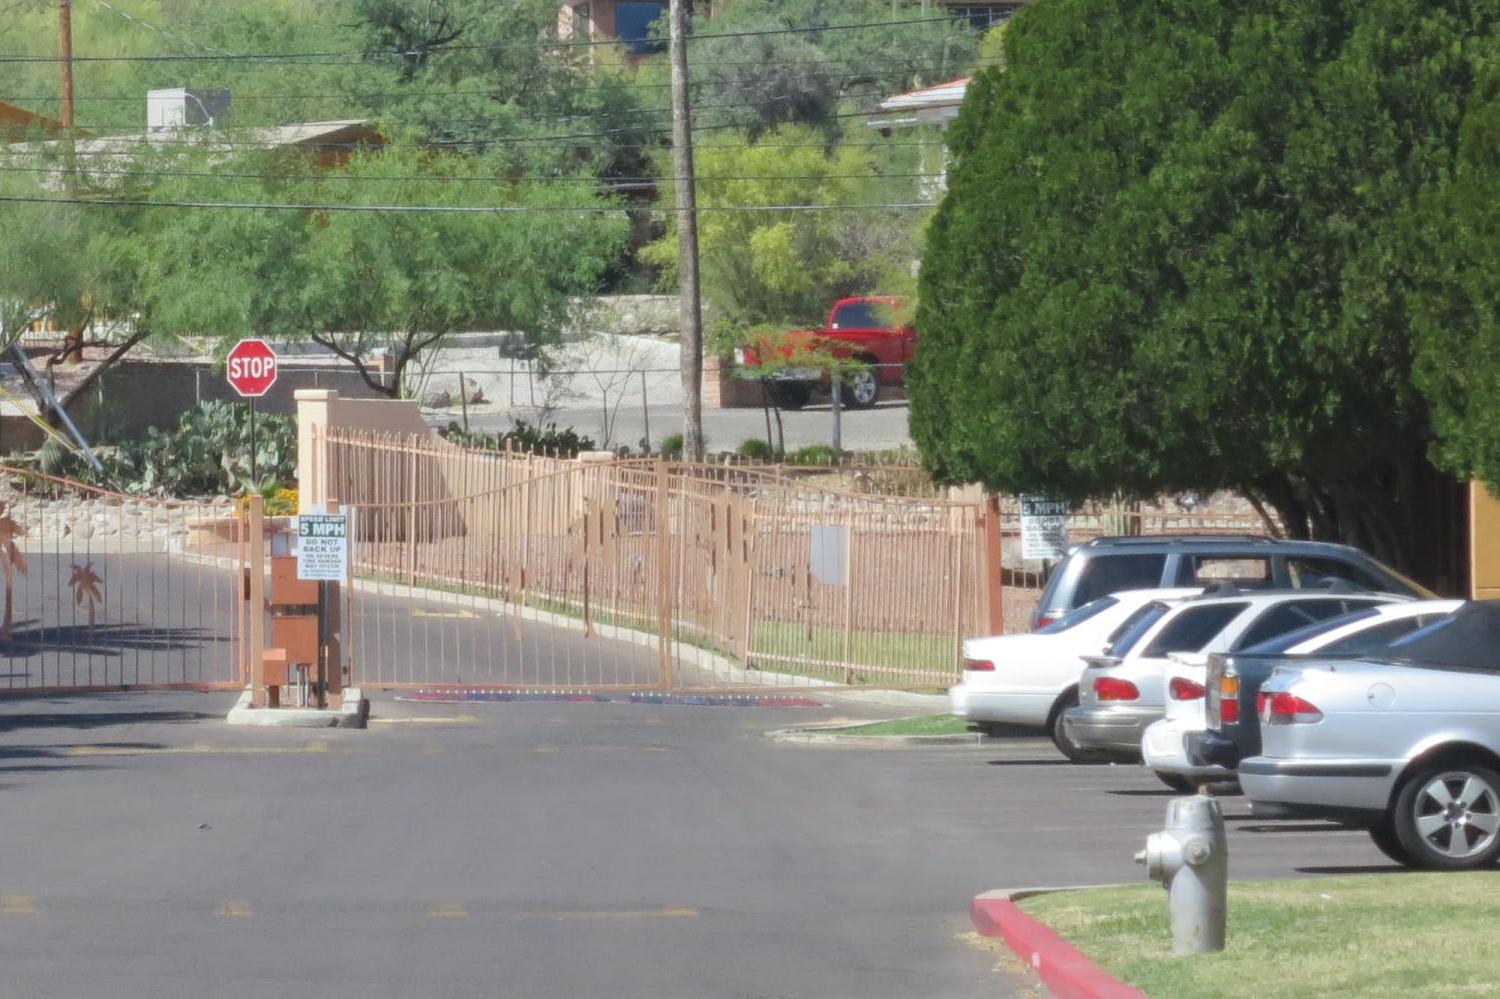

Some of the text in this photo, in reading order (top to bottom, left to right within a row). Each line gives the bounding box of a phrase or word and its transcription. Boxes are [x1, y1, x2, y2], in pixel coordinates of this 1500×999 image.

[230, 357, 274, 379] STOP
[1034, 502, 1065, 514] MPH
[300, 522, 345, 536] 5 MPH
